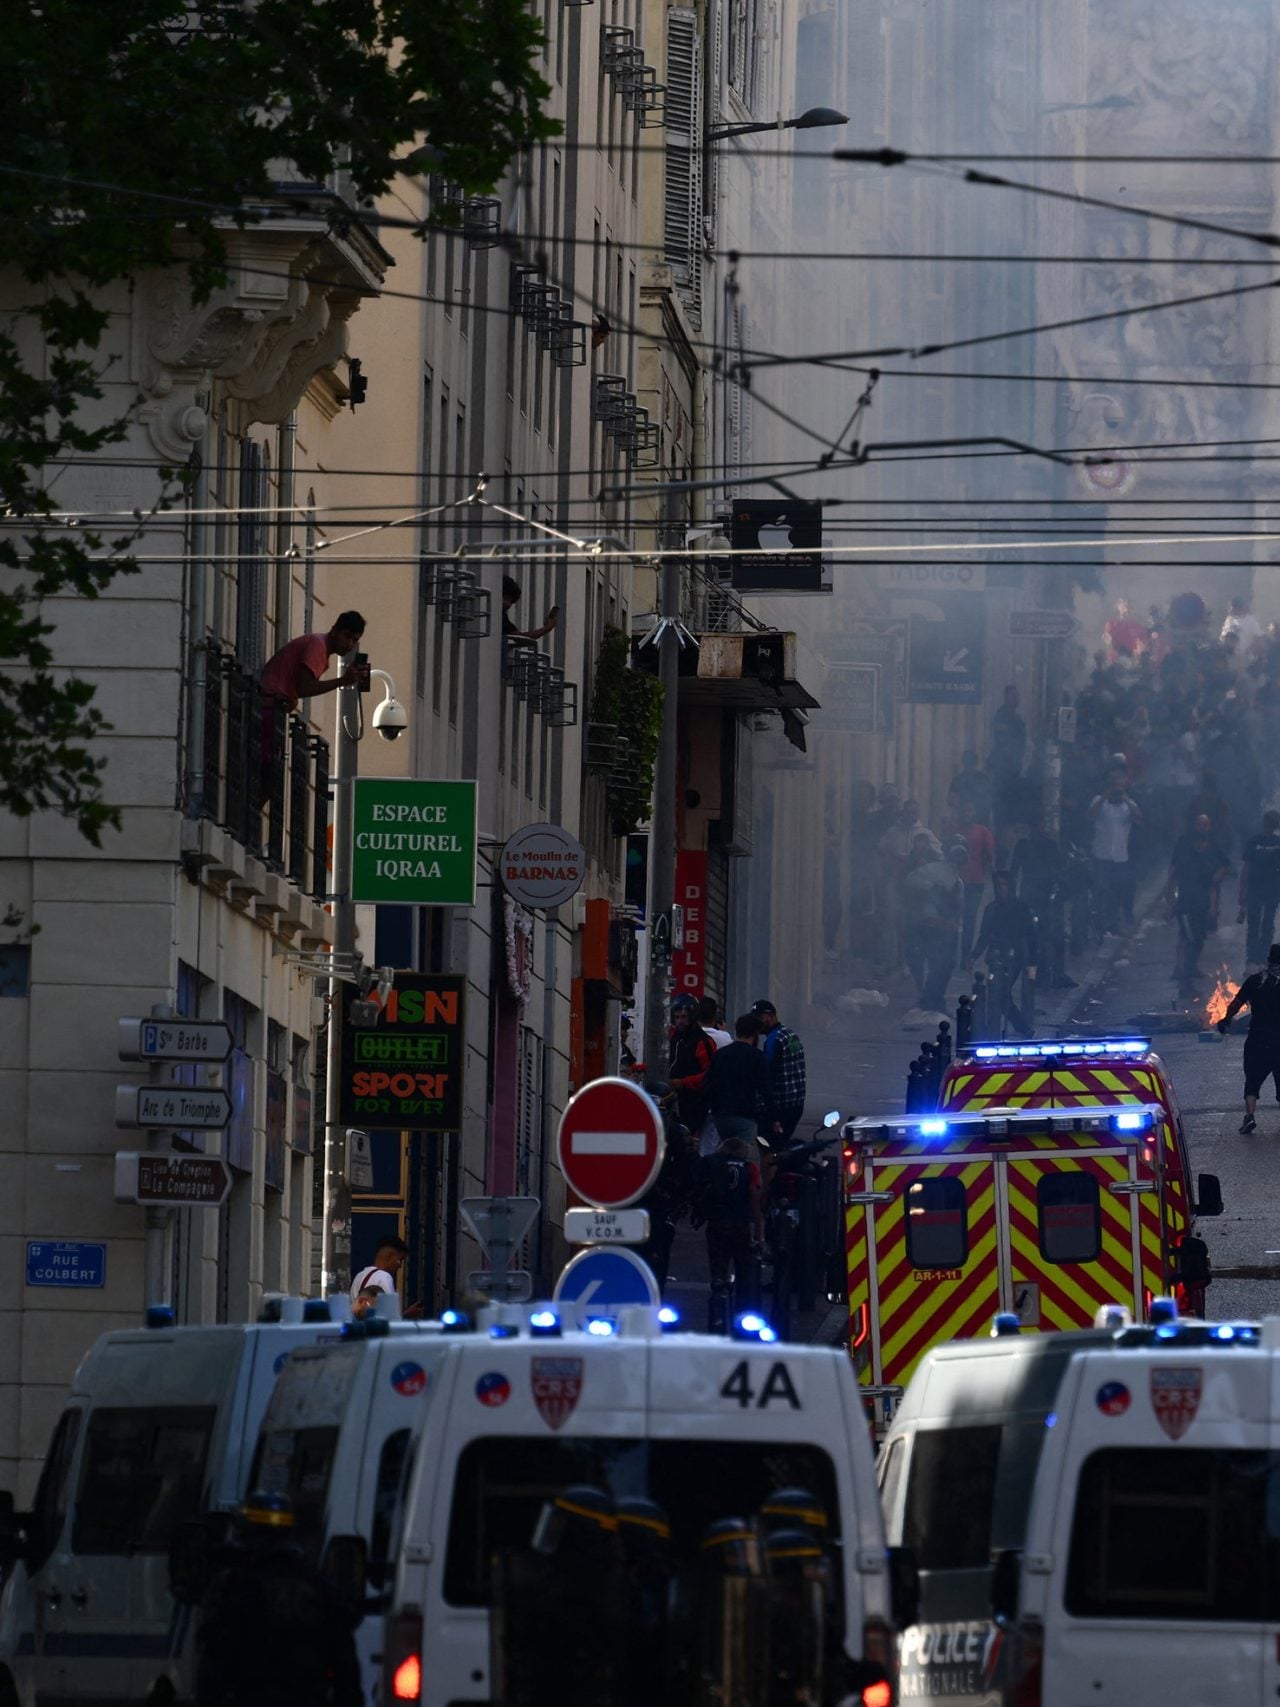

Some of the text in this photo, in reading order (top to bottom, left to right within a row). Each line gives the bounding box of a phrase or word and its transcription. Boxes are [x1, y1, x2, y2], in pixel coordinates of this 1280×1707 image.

[372, 804, 447, 823] ESPACE
[356, 832, 463, 852] CULTUREL
[506, 851, 578, 862] Le Moulin de
[375, 859, 442, 880] IQRAA
[506, 866, 578, 881] BARNAS
[178, 1031, 207, 1051] Barbe
[360, 1037, 442, 1060] OUTLET
[352, 1072, 449, 1099] SPORT
[142, 1097, 222, 1123] Arc de Triomphe
[353, 1099, 446, 1115] FOR EVER
[594, 1215, 617, 1224] SAUF
[586, 1228, 625, 1238] V.C.O.M.
[53, 1255, 79, 1266] RUE
[35, 1268, 97, 1280] COLBERT
[915, 1270, 957, 1281] AR-1-11
[721, 1360, 802, 1410] 4A
[901, 1621, 981, 1666] POLICE
[900, 1669, 976, 1697] NATIONALE
